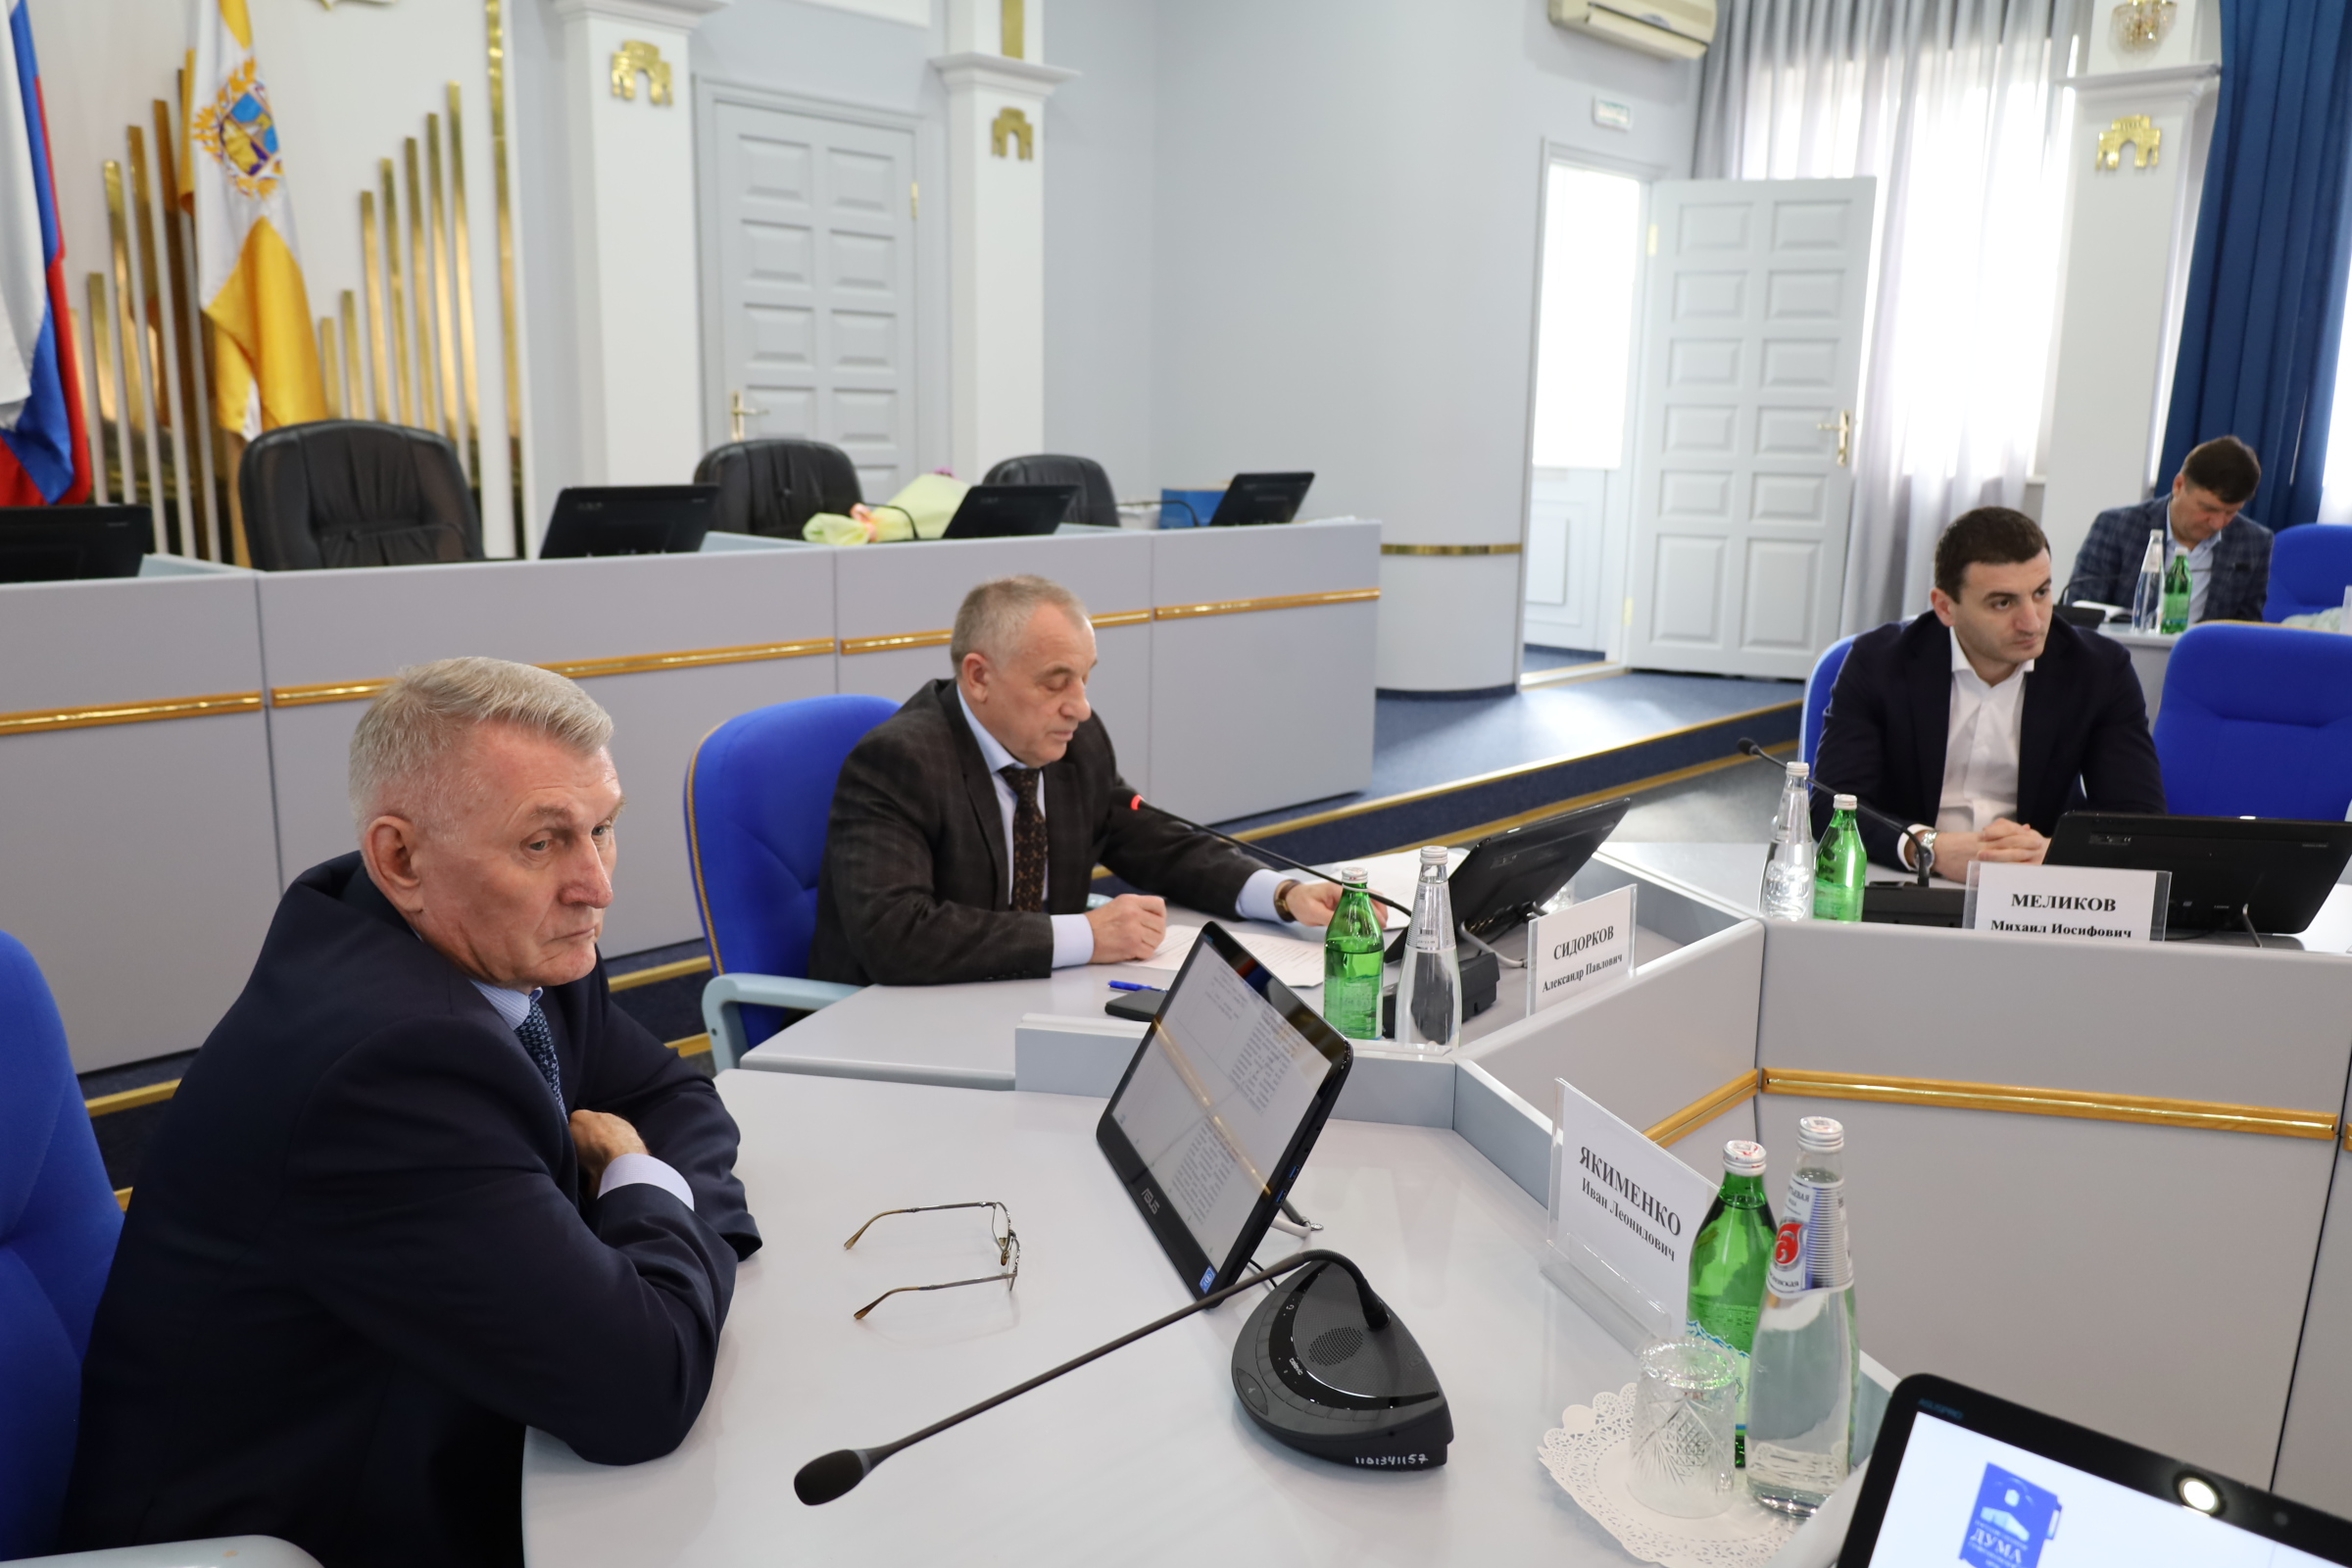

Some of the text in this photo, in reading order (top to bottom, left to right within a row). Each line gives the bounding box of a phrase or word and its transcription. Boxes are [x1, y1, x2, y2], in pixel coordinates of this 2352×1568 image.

[2011, 893, 2117, 912] МЕЛИКОВ
[1553, 925, 1615, 960] СИДОРКОВ
[1990, 919, 2132, 938] Михаил Иосифович
[1543, 954, 1623, 993] Александр Павлович
[1141, 1188, 1160, 1215] ASUS
[1579, 1146, 1682, 1237] ЯКИМЕНКО
[1582, 1177, 1676, 1262] Иван Леонидович
[1969, 1527, 2023, 1565] ДУМА
